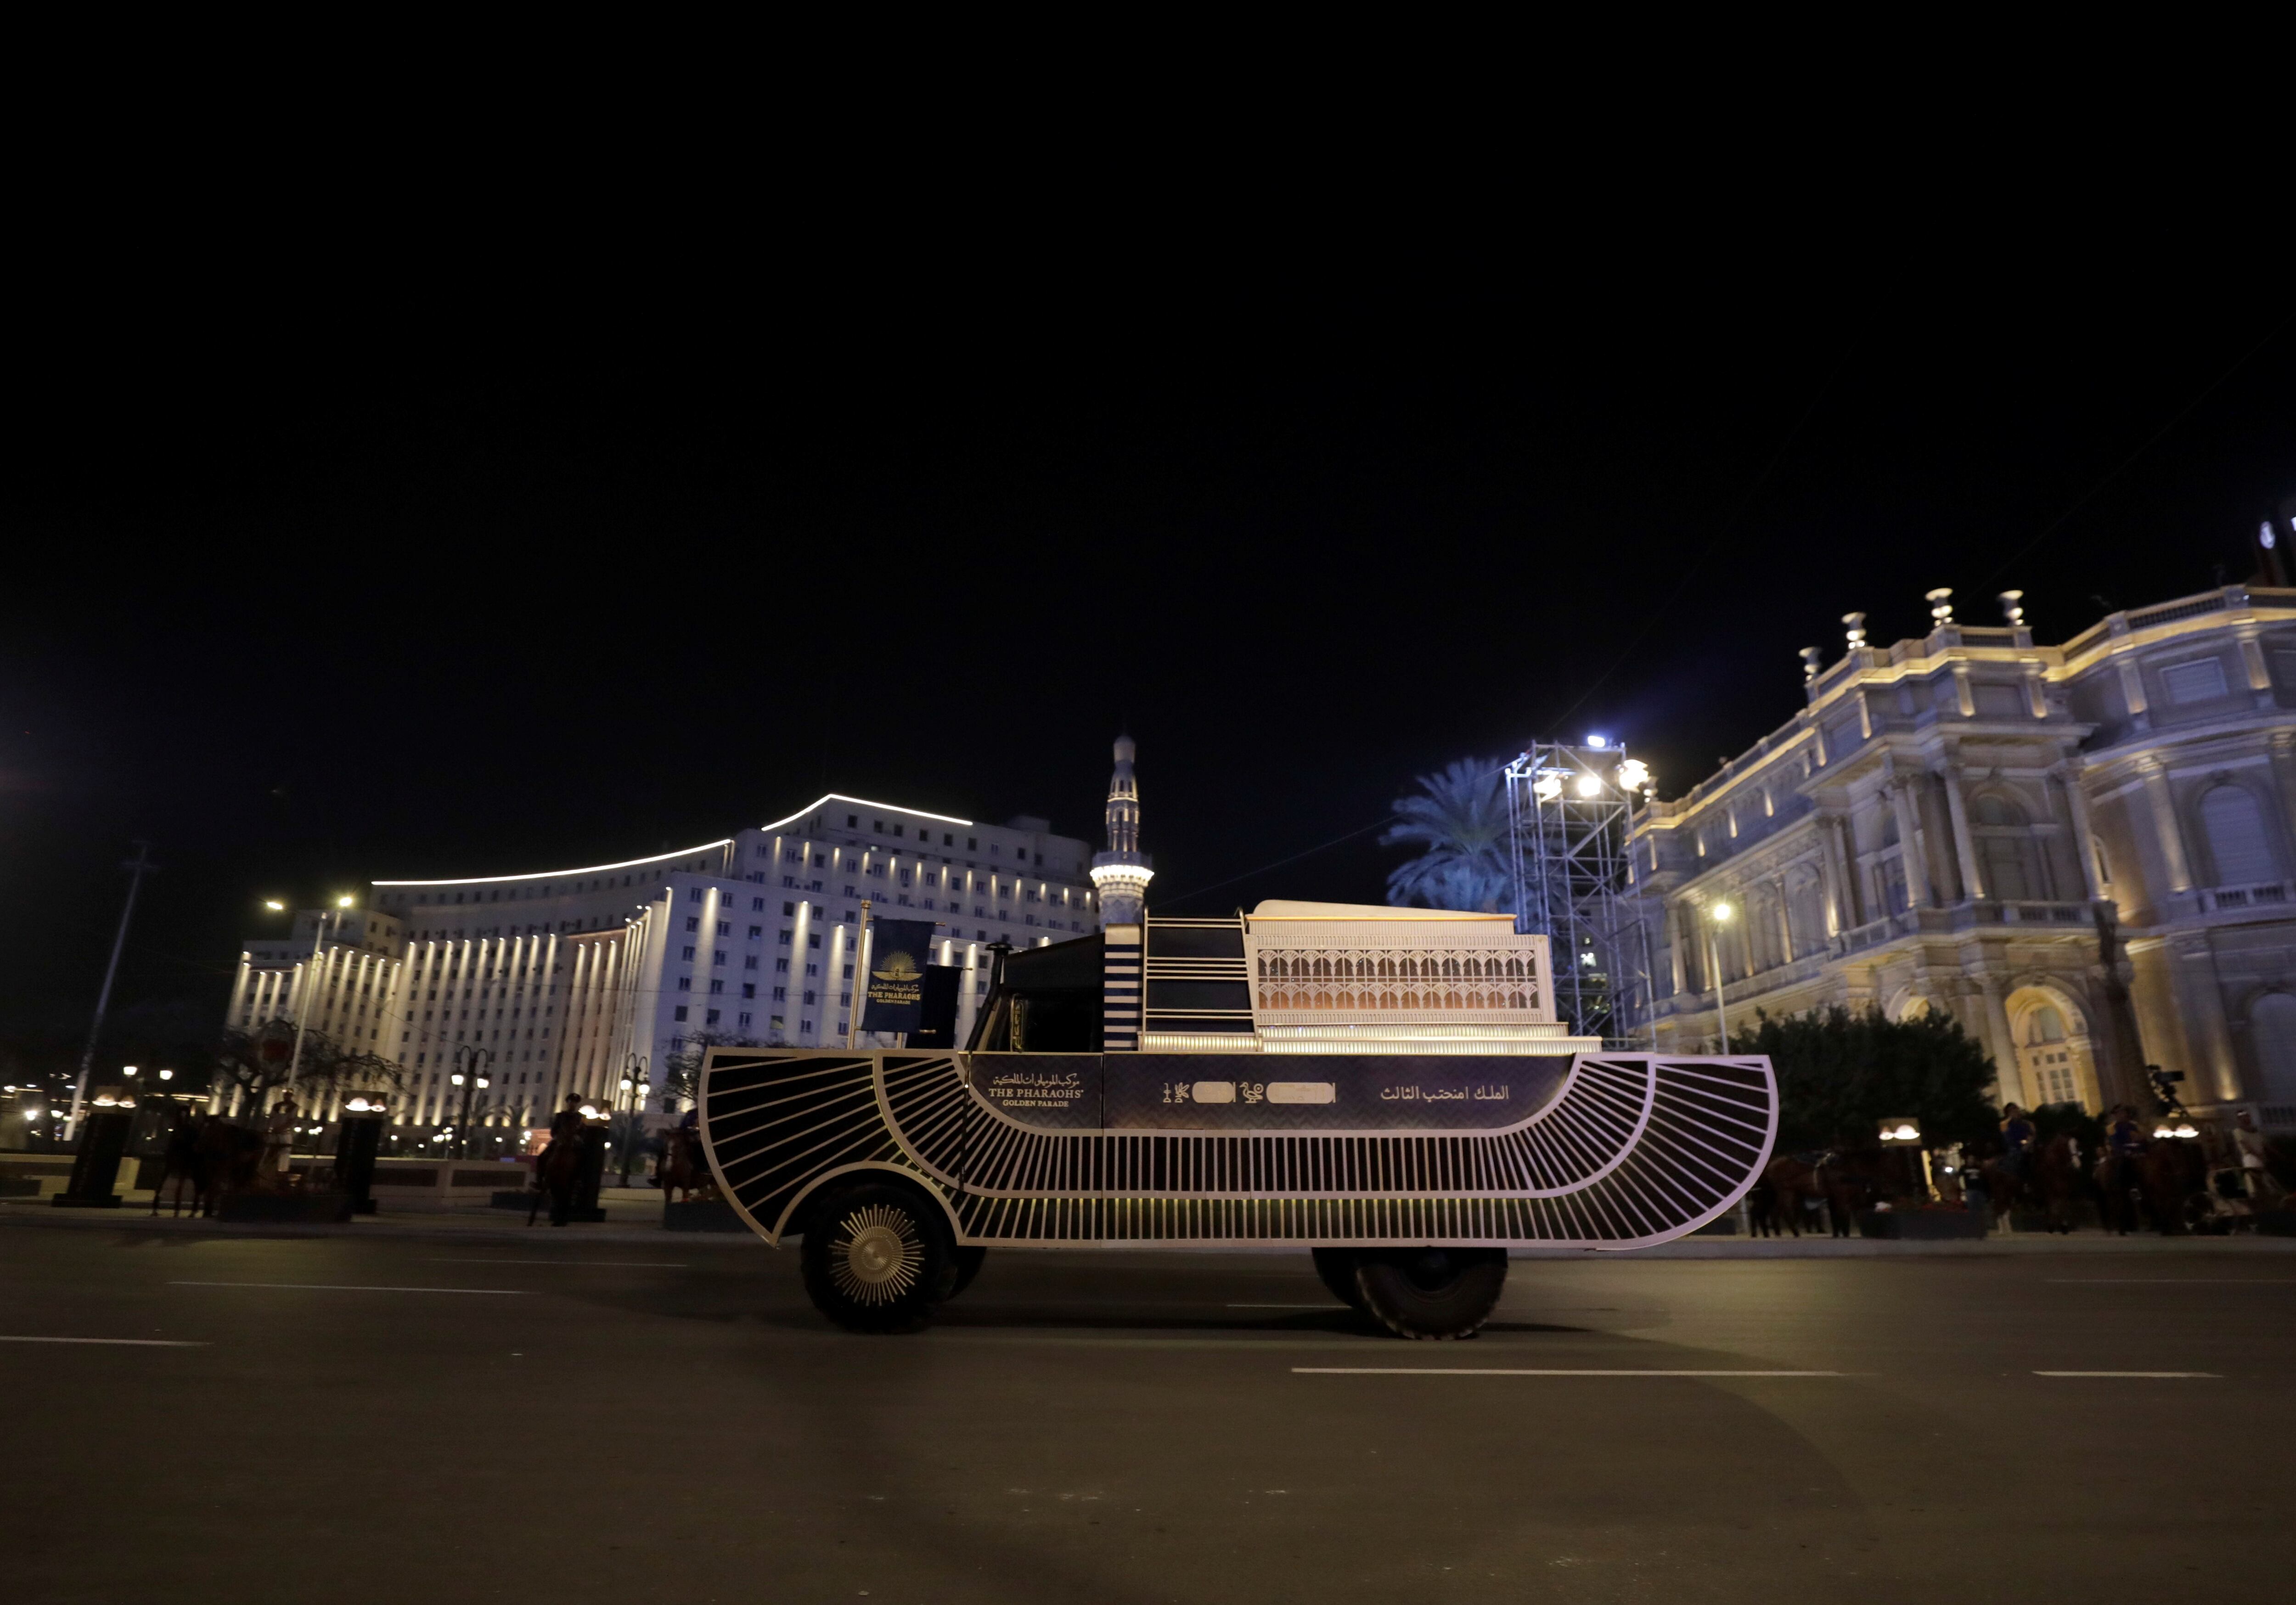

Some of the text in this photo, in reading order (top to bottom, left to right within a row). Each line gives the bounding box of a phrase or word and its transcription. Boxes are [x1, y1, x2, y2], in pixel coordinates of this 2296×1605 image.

[884, 992, 921, 1001] PHARAOHS
[993, 1073, 1023, 1085] الملكية
[1058, 1073, 1080, 1089] موكب
[988, 1088, 1081, 1098] THE PHARAOHS
[1380, 1085, 1509, 1103] الملك امنحتب الثالث
